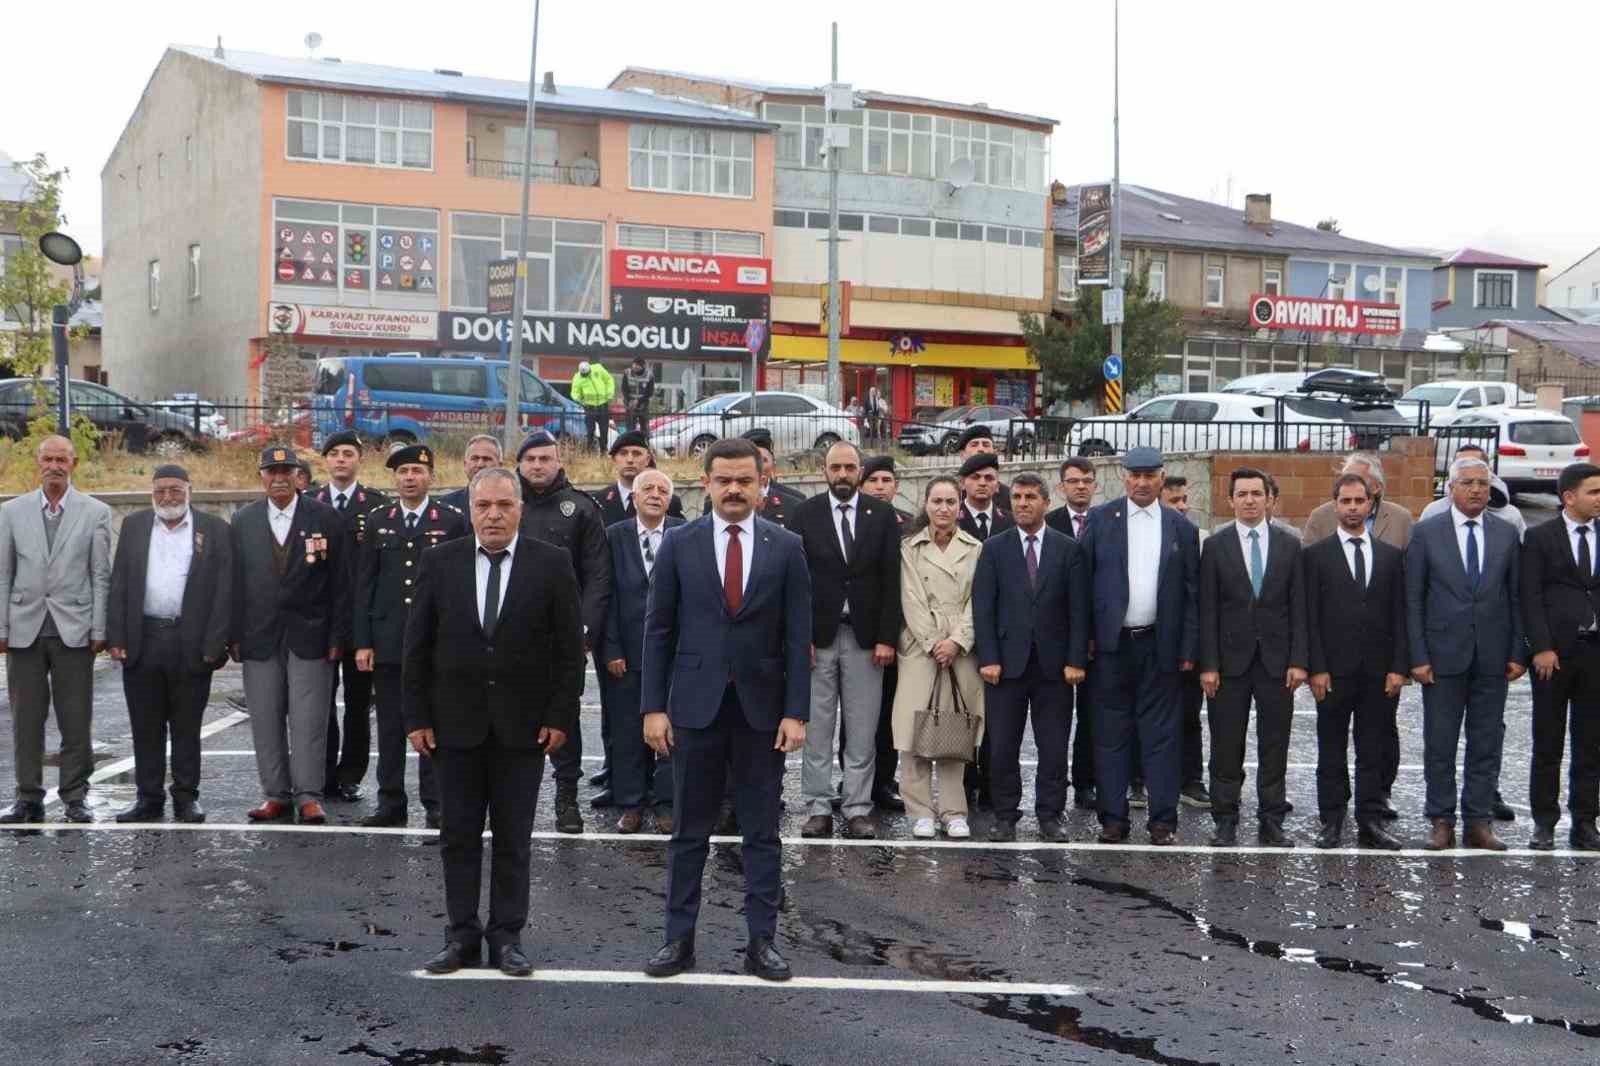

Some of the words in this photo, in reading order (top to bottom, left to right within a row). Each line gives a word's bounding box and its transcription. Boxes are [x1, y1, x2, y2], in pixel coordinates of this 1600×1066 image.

[626, 255, 721, 275] SANICA
[674, 298, 736, 317] Polisan
[1275, 300, 1358, 328] AVANTAJ
